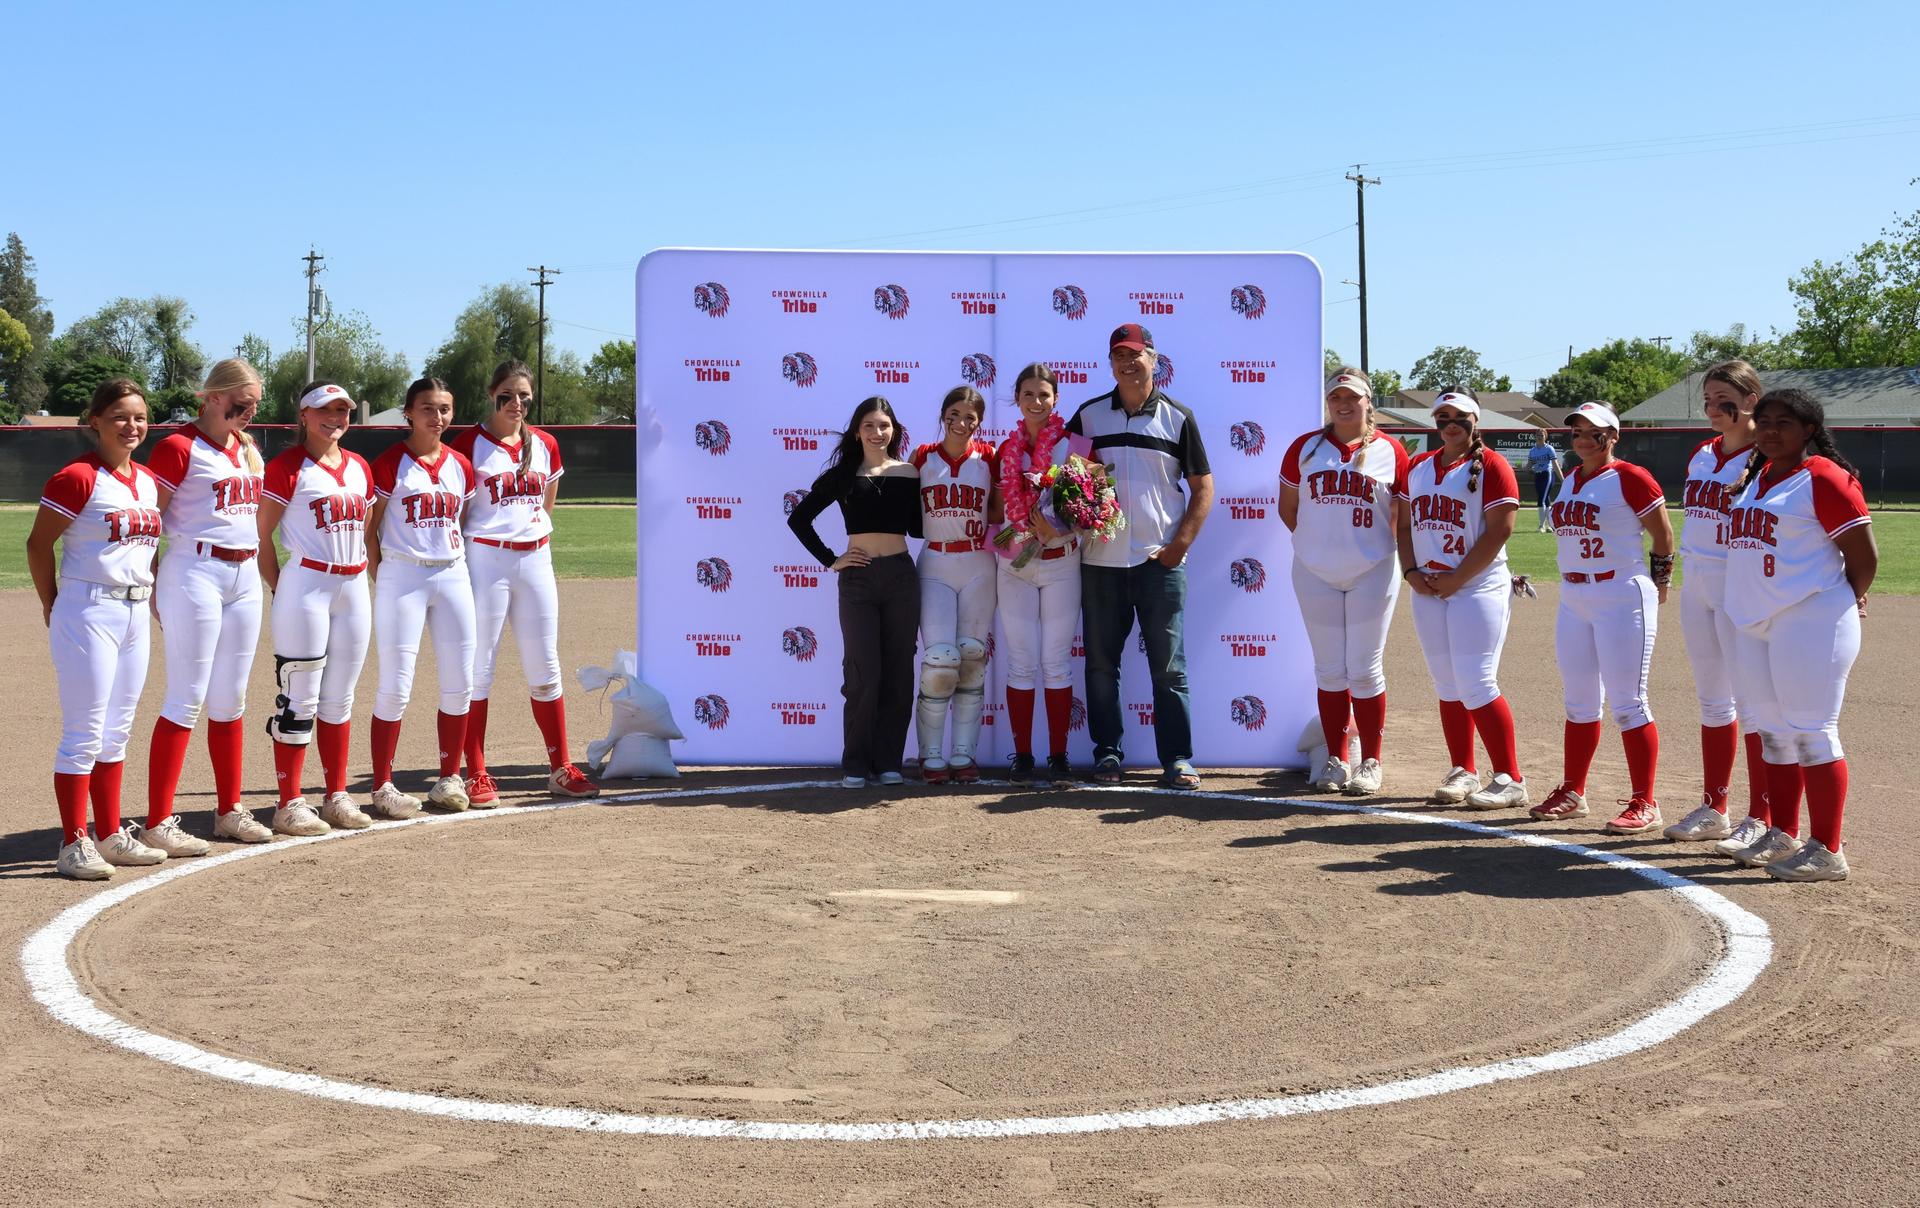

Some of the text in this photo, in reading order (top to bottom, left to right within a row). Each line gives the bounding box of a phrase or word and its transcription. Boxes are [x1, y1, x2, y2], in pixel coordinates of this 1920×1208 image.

[772, 428, 828, 436] CHOWCHILLA
[211, 475, 263, 511] TRIB
[1315, 497, 1365, 508] SOFTBALL
[309, 491, 367, 530] TRIB
[930, 509, 976, 518] SOFTBALL
[1352, 507, 1374, 529] 88
[965, 520, 984, 538] 00
[1442, 533, 1466, 556] 24
[1579, 537, 1605, 559] 32
[1763, 553, 1776, 578] 8
